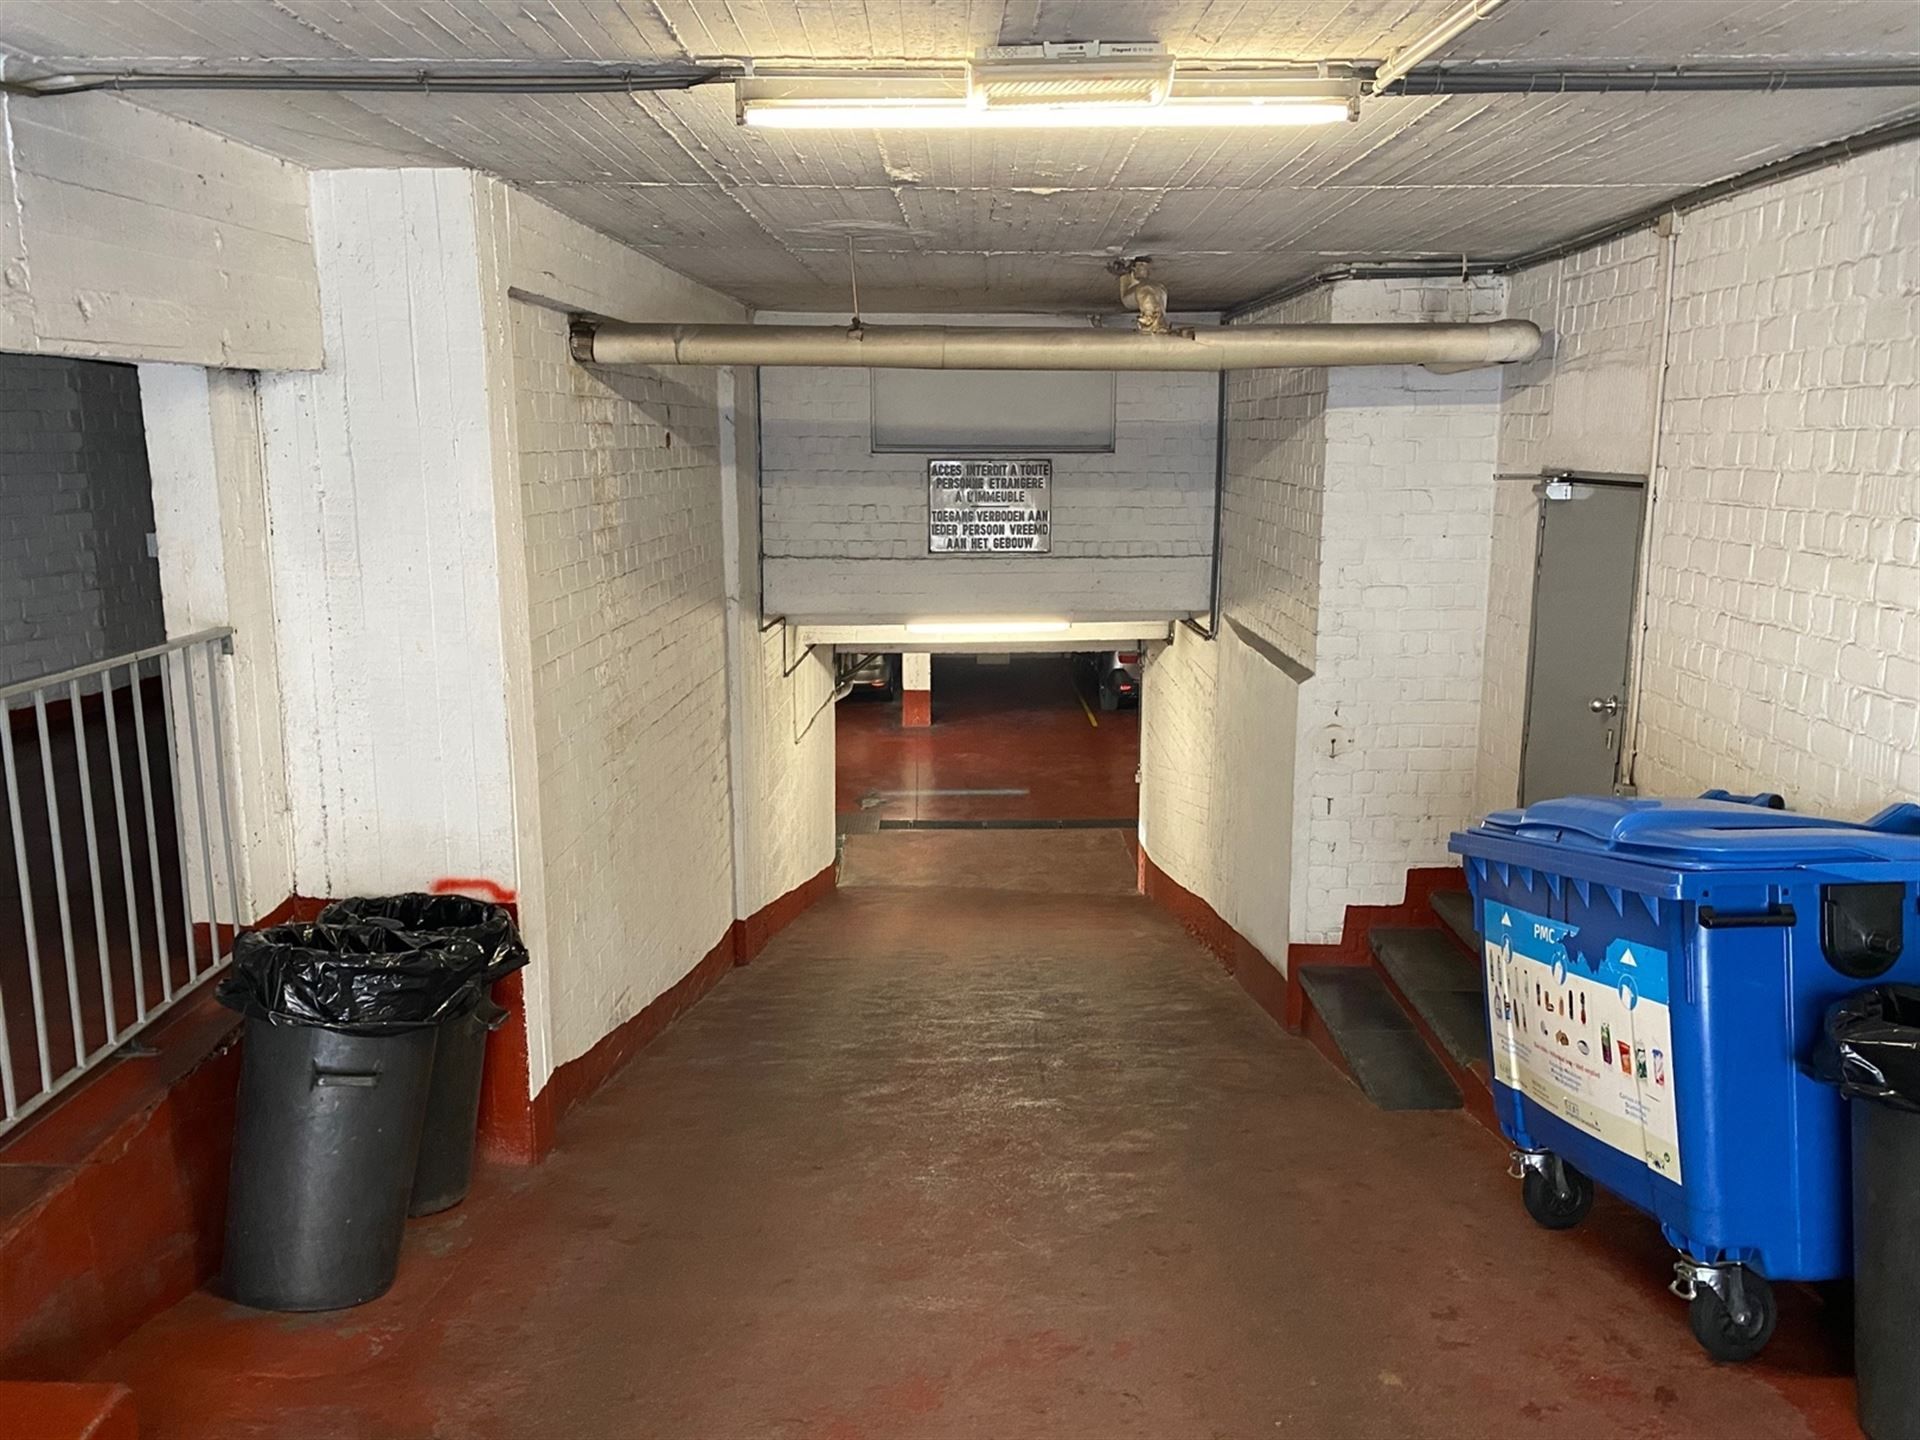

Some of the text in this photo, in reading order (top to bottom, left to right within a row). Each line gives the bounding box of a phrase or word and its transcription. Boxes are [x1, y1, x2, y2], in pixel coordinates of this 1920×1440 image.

[931, 464, 1049, 476] ACCES INTERDIT A TOUTE
[936, 477, 1044, 489] PERSONNE ETRANGERE
[955, 491, 1025, 502] A L'IMMEUBLE
[931, 510, 1049, 522] TOEGANG VERBODEN AAN
[931, 524, 1049, 535] IEDER PERSOON VREEMD
[946, 537, 1034, 549] AAN HET GEBOUW
[1533, 923, 1556, 944] PMC
